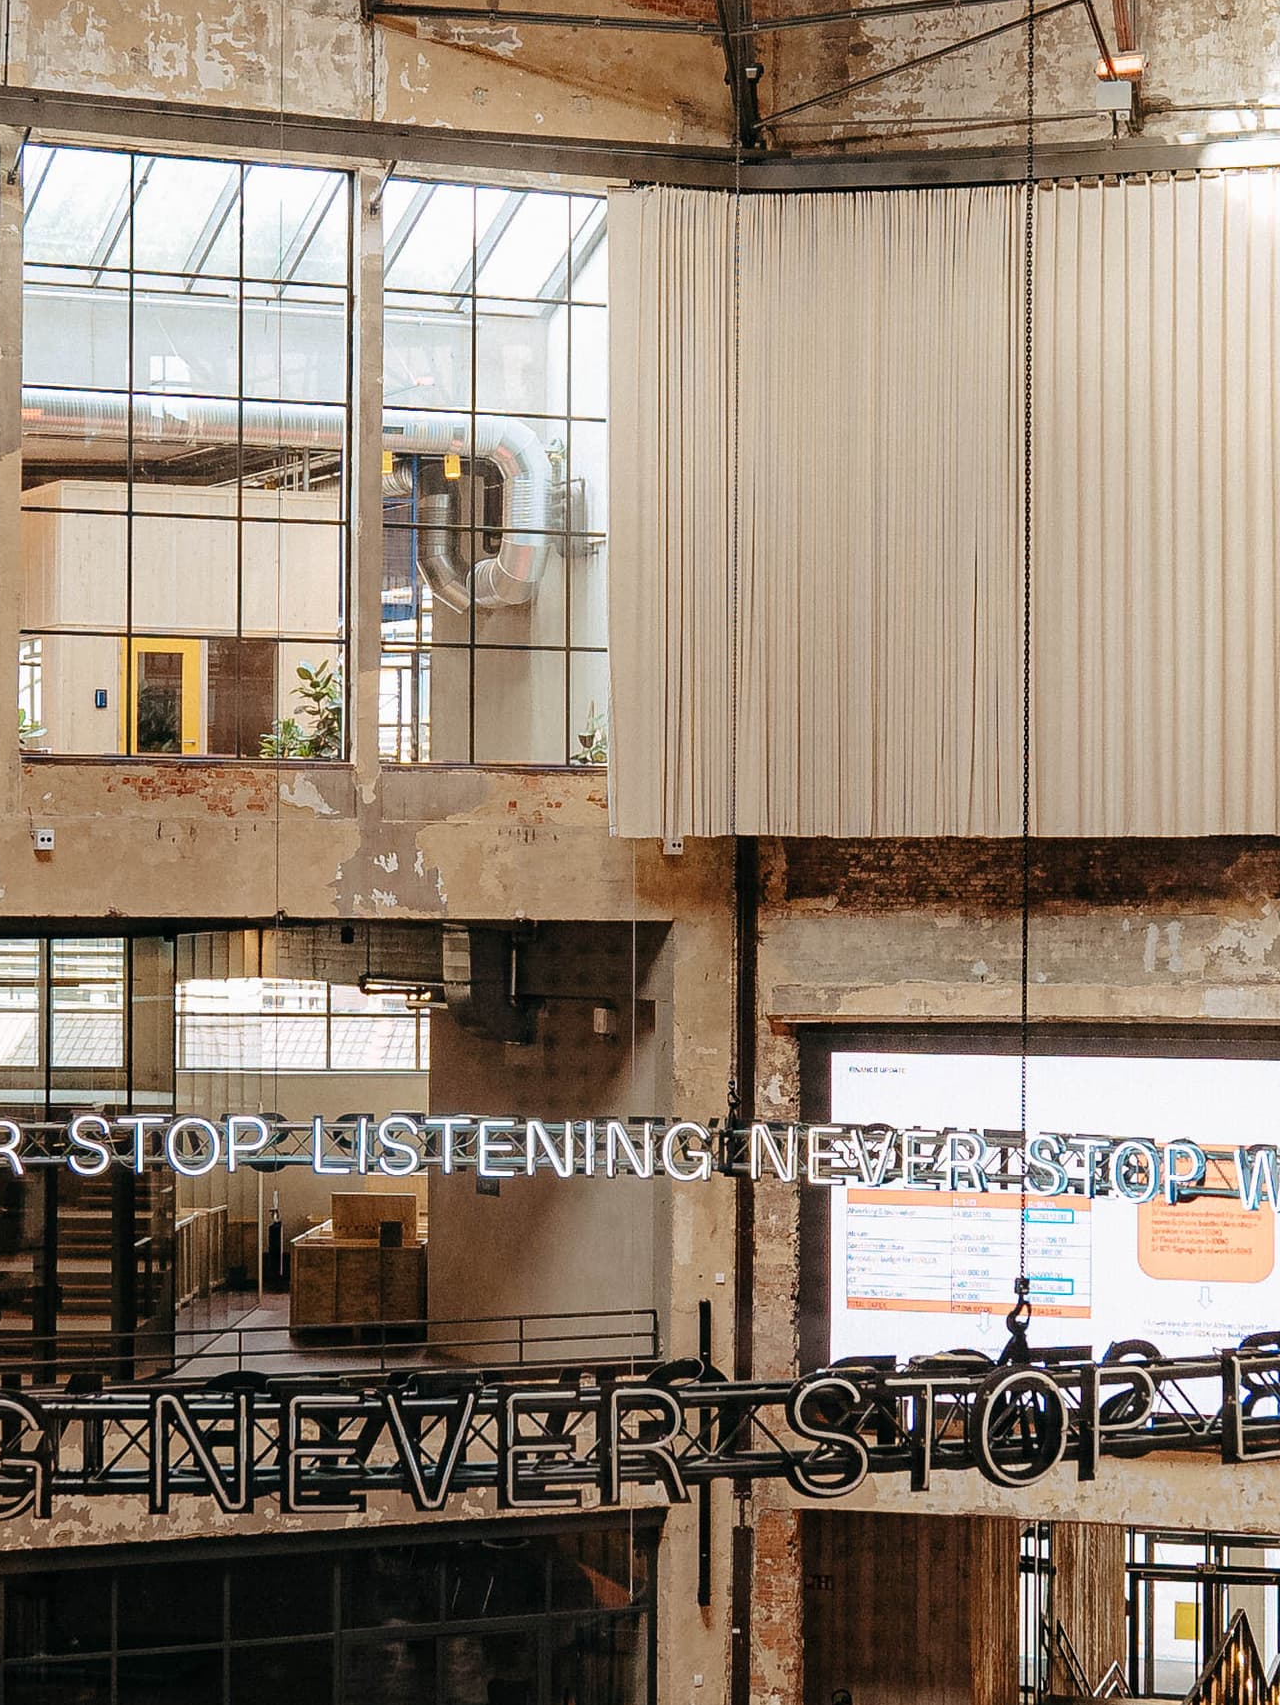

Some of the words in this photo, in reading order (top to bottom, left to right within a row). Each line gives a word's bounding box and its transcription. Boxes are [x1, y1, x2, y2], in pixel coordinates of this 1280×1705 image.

[66, 1115, 270, 1177] STOP
[312, 1117, 711, 1182] LISTENING
[750, 1122, 990, 1193] NEVER
[1024, 1133, 1207, 1205] STOP
[153, 1388, 688, 1513] NEVER
[792, 1364, 1155, 1497] STOP
